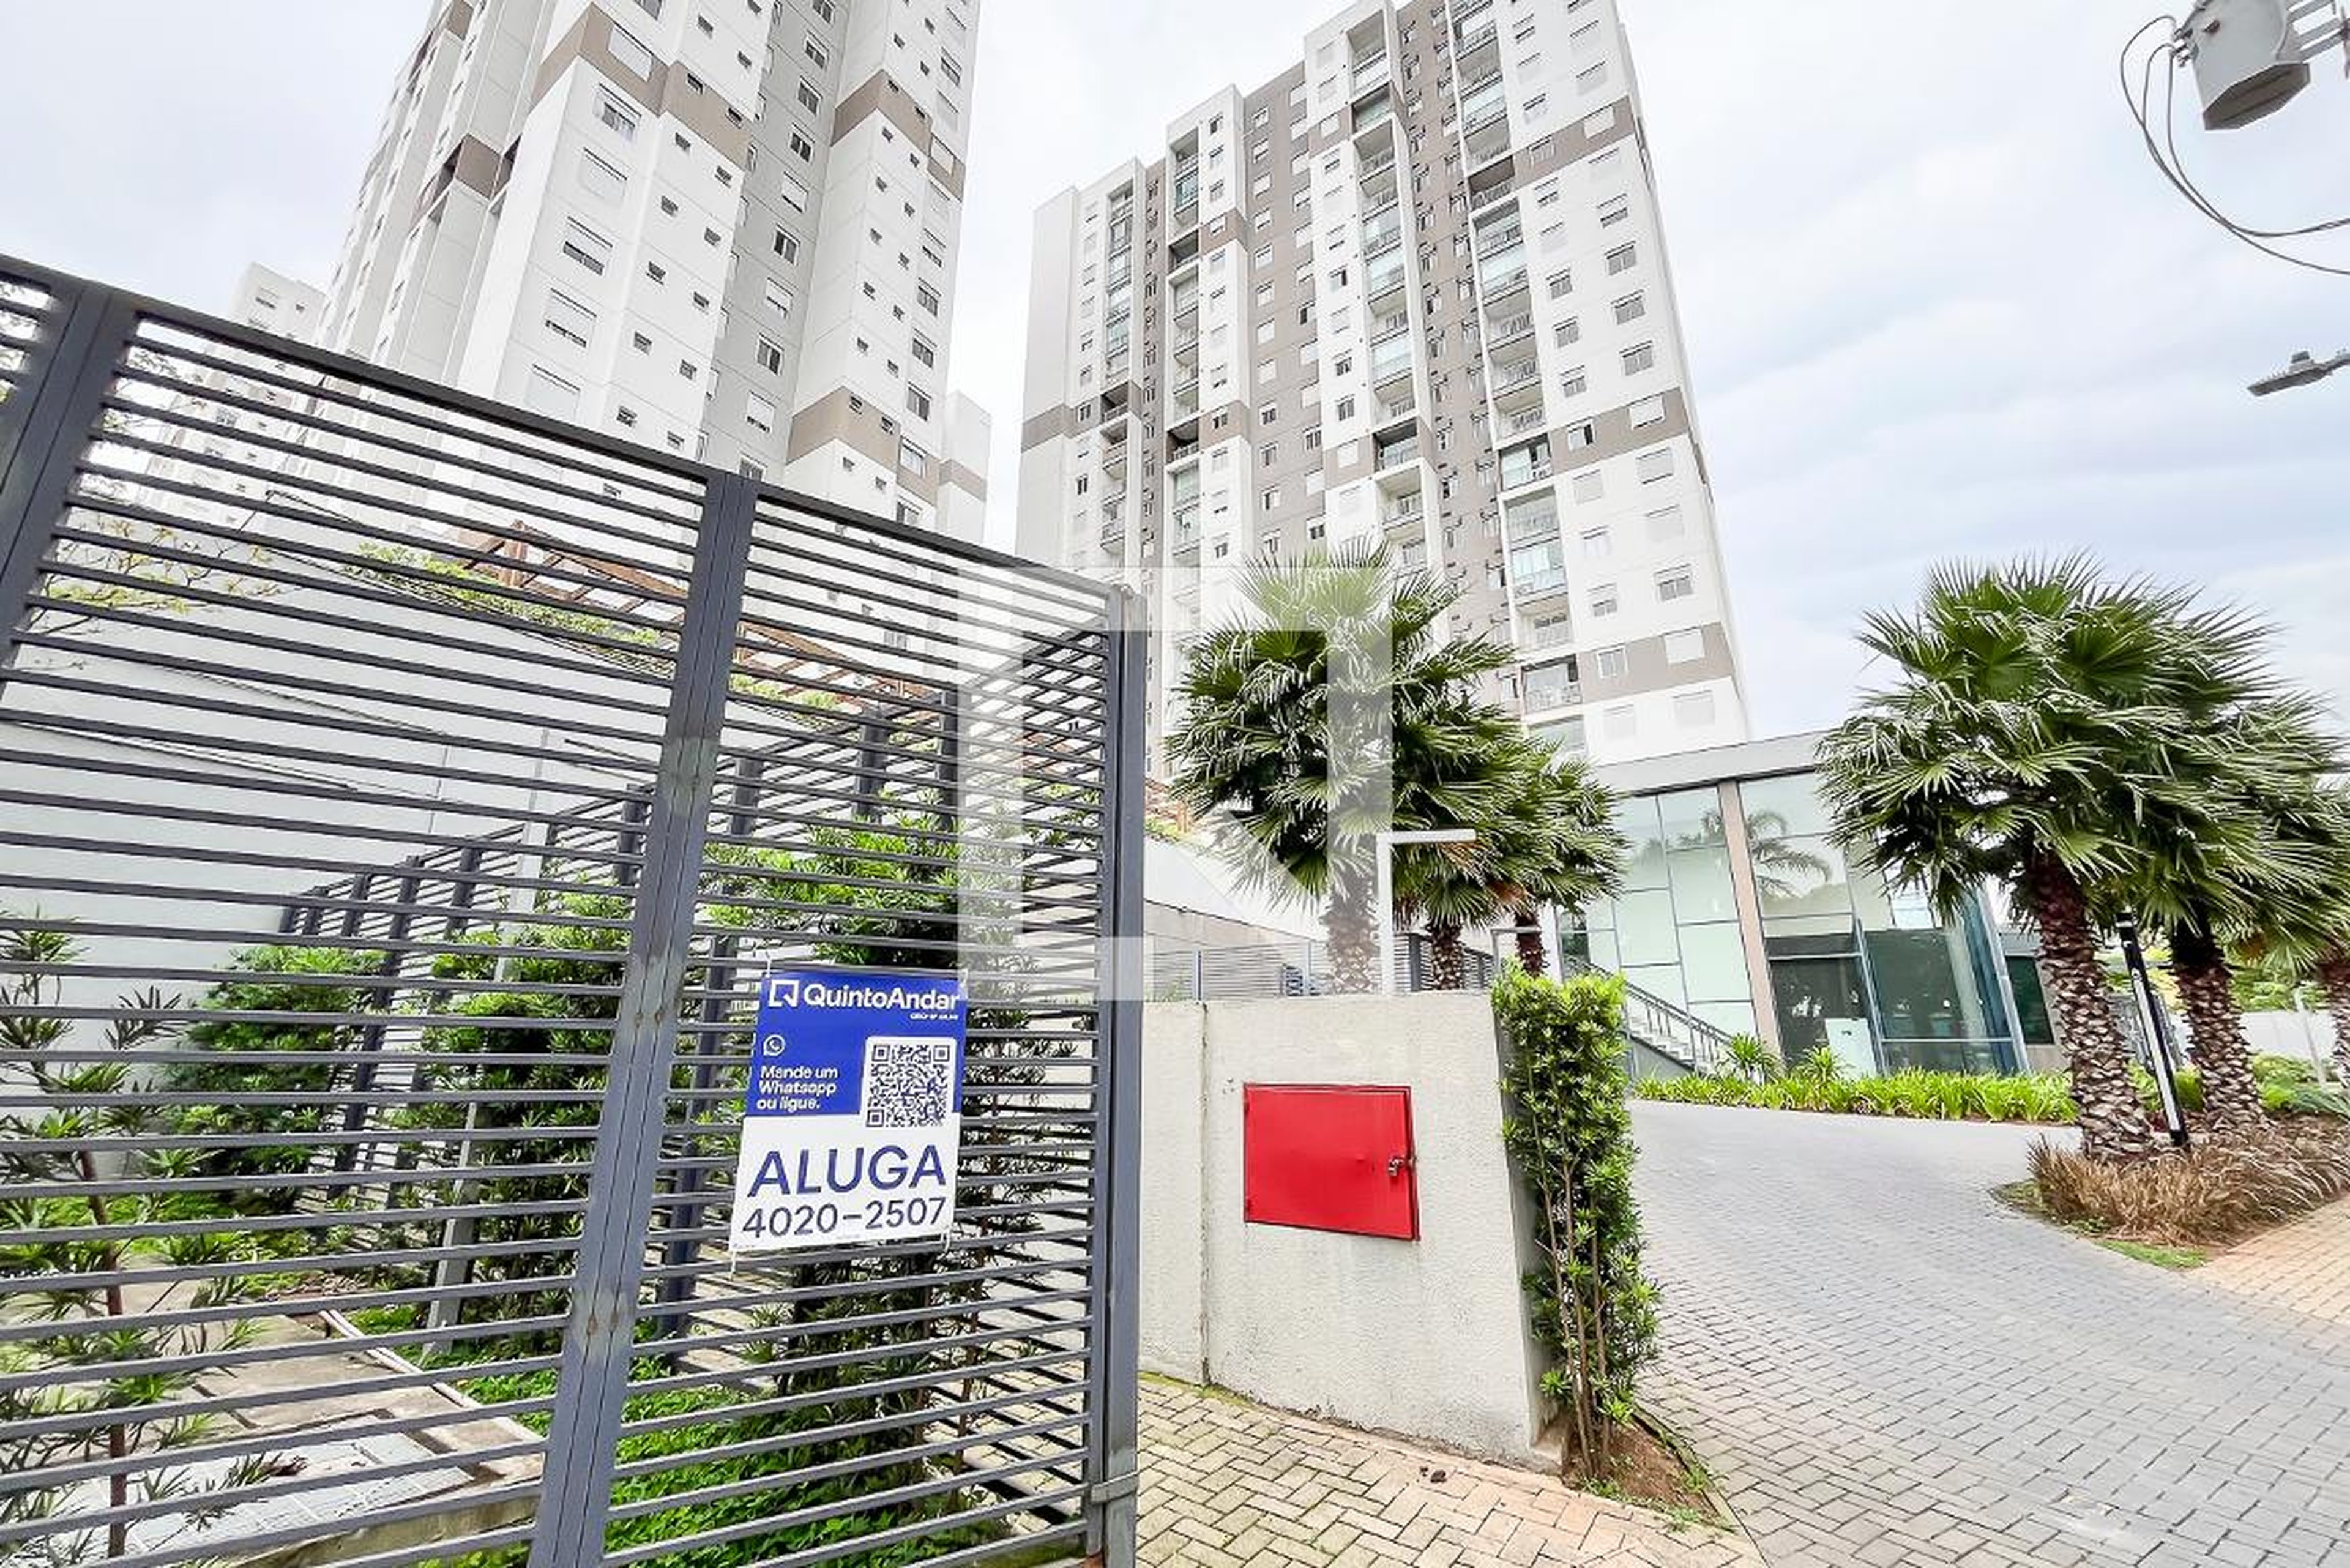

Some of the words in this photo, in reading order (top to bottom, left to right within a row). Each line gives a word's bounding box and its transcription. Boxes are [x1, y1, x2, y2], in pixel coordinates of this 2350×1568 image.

[804, 984, 960, 1010] QuintoAndar
[761, 1066, 813, 1079] Mande
[815, 1067, 838, 1078] um
[759, 1080, 837, 1097] Whatsapp
[756, 1099, 777, 1110] ou
[747, 1144, 946, 1197] ALUGA
[742, 1197, 946, 1238] 4020-2507
